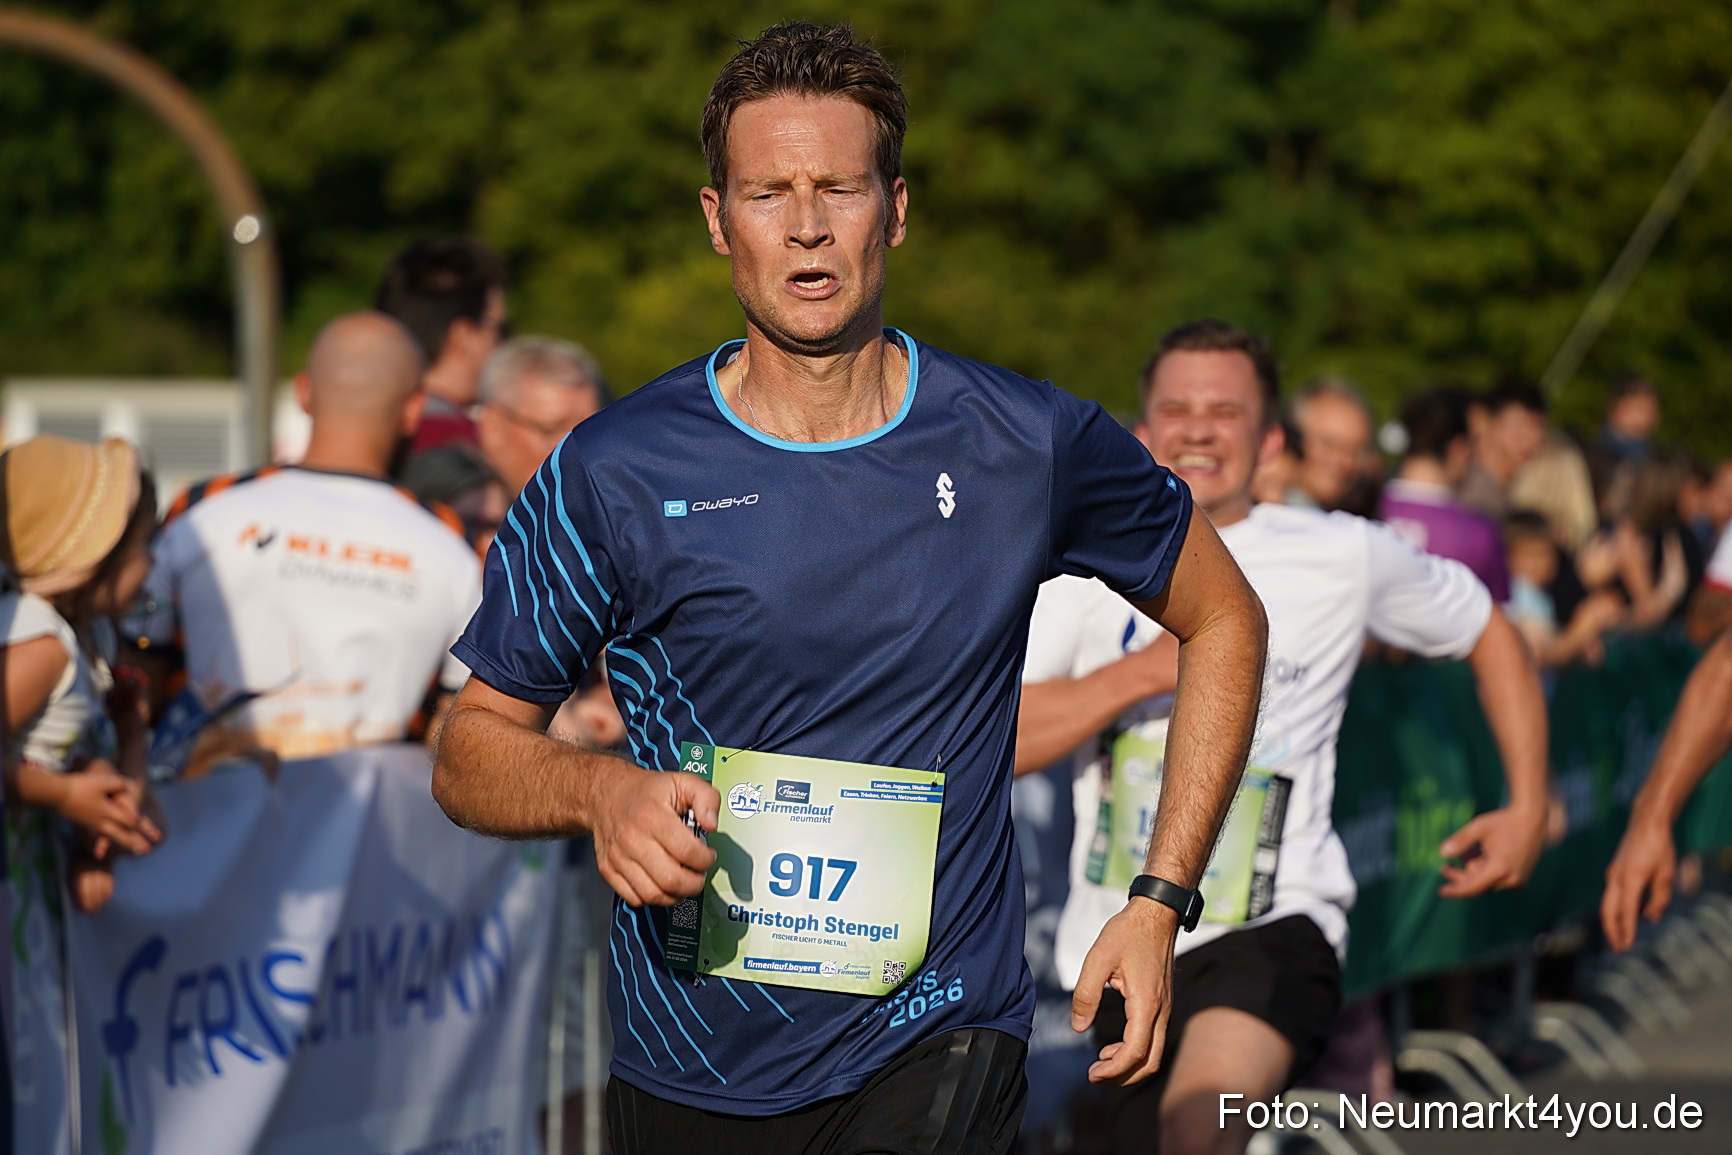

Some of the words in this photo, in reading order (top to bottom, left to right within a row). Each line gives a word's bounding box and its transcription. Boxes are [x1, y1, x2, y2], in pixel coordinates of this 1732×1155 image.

[692, 494, 759, 512] owayo
[683, 761, 708, 775] AOK
[763, 801, 834, 816] Firmenlauf
[790, 815, 832, 824] neumarkt
[768, 852, 858, 902] 917
[727, 904, 819, 933] Christoph
[824, 916, 900, 942] Stengel
[771, 932, 800, 942] FISCHER
[799, 936, 817, 944] LICHT
[823, 939, 848, 947] METALL
[747, 959, 817, 973] firmenlauf.bayern
[837, 968, 871, 977] Firmenlauf
[889, 977, 964, 1029] 2026
